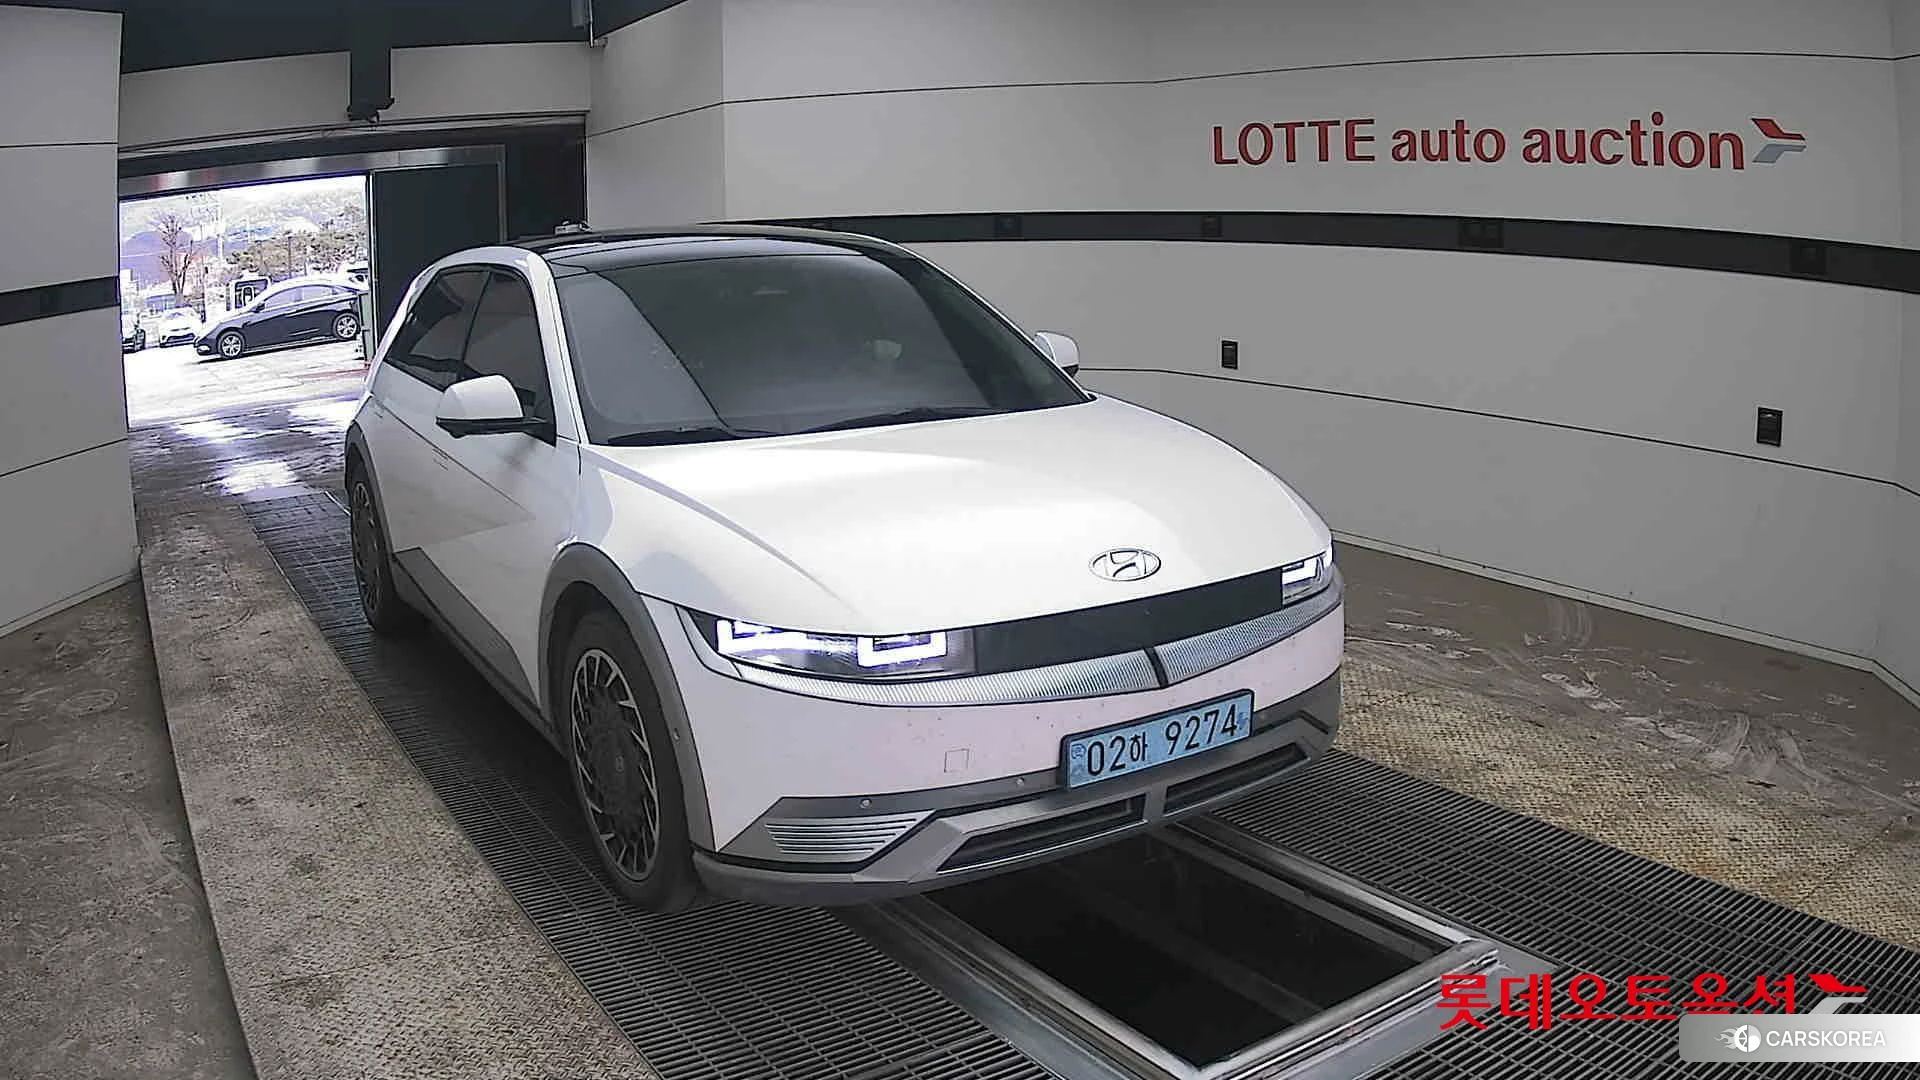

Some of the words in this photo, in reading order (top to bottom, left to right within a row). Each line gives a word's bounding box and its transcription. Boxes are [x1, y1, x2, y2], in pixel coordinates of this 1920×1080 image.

[1212, 118, 1376, 165] LOTTE
[1390, 118, 1506, 163] auto
[1522, 111, 1745, 170] auction
[1087, 731, 1149, 777] 02하
[1165, 703, 1238, 756] 9274
